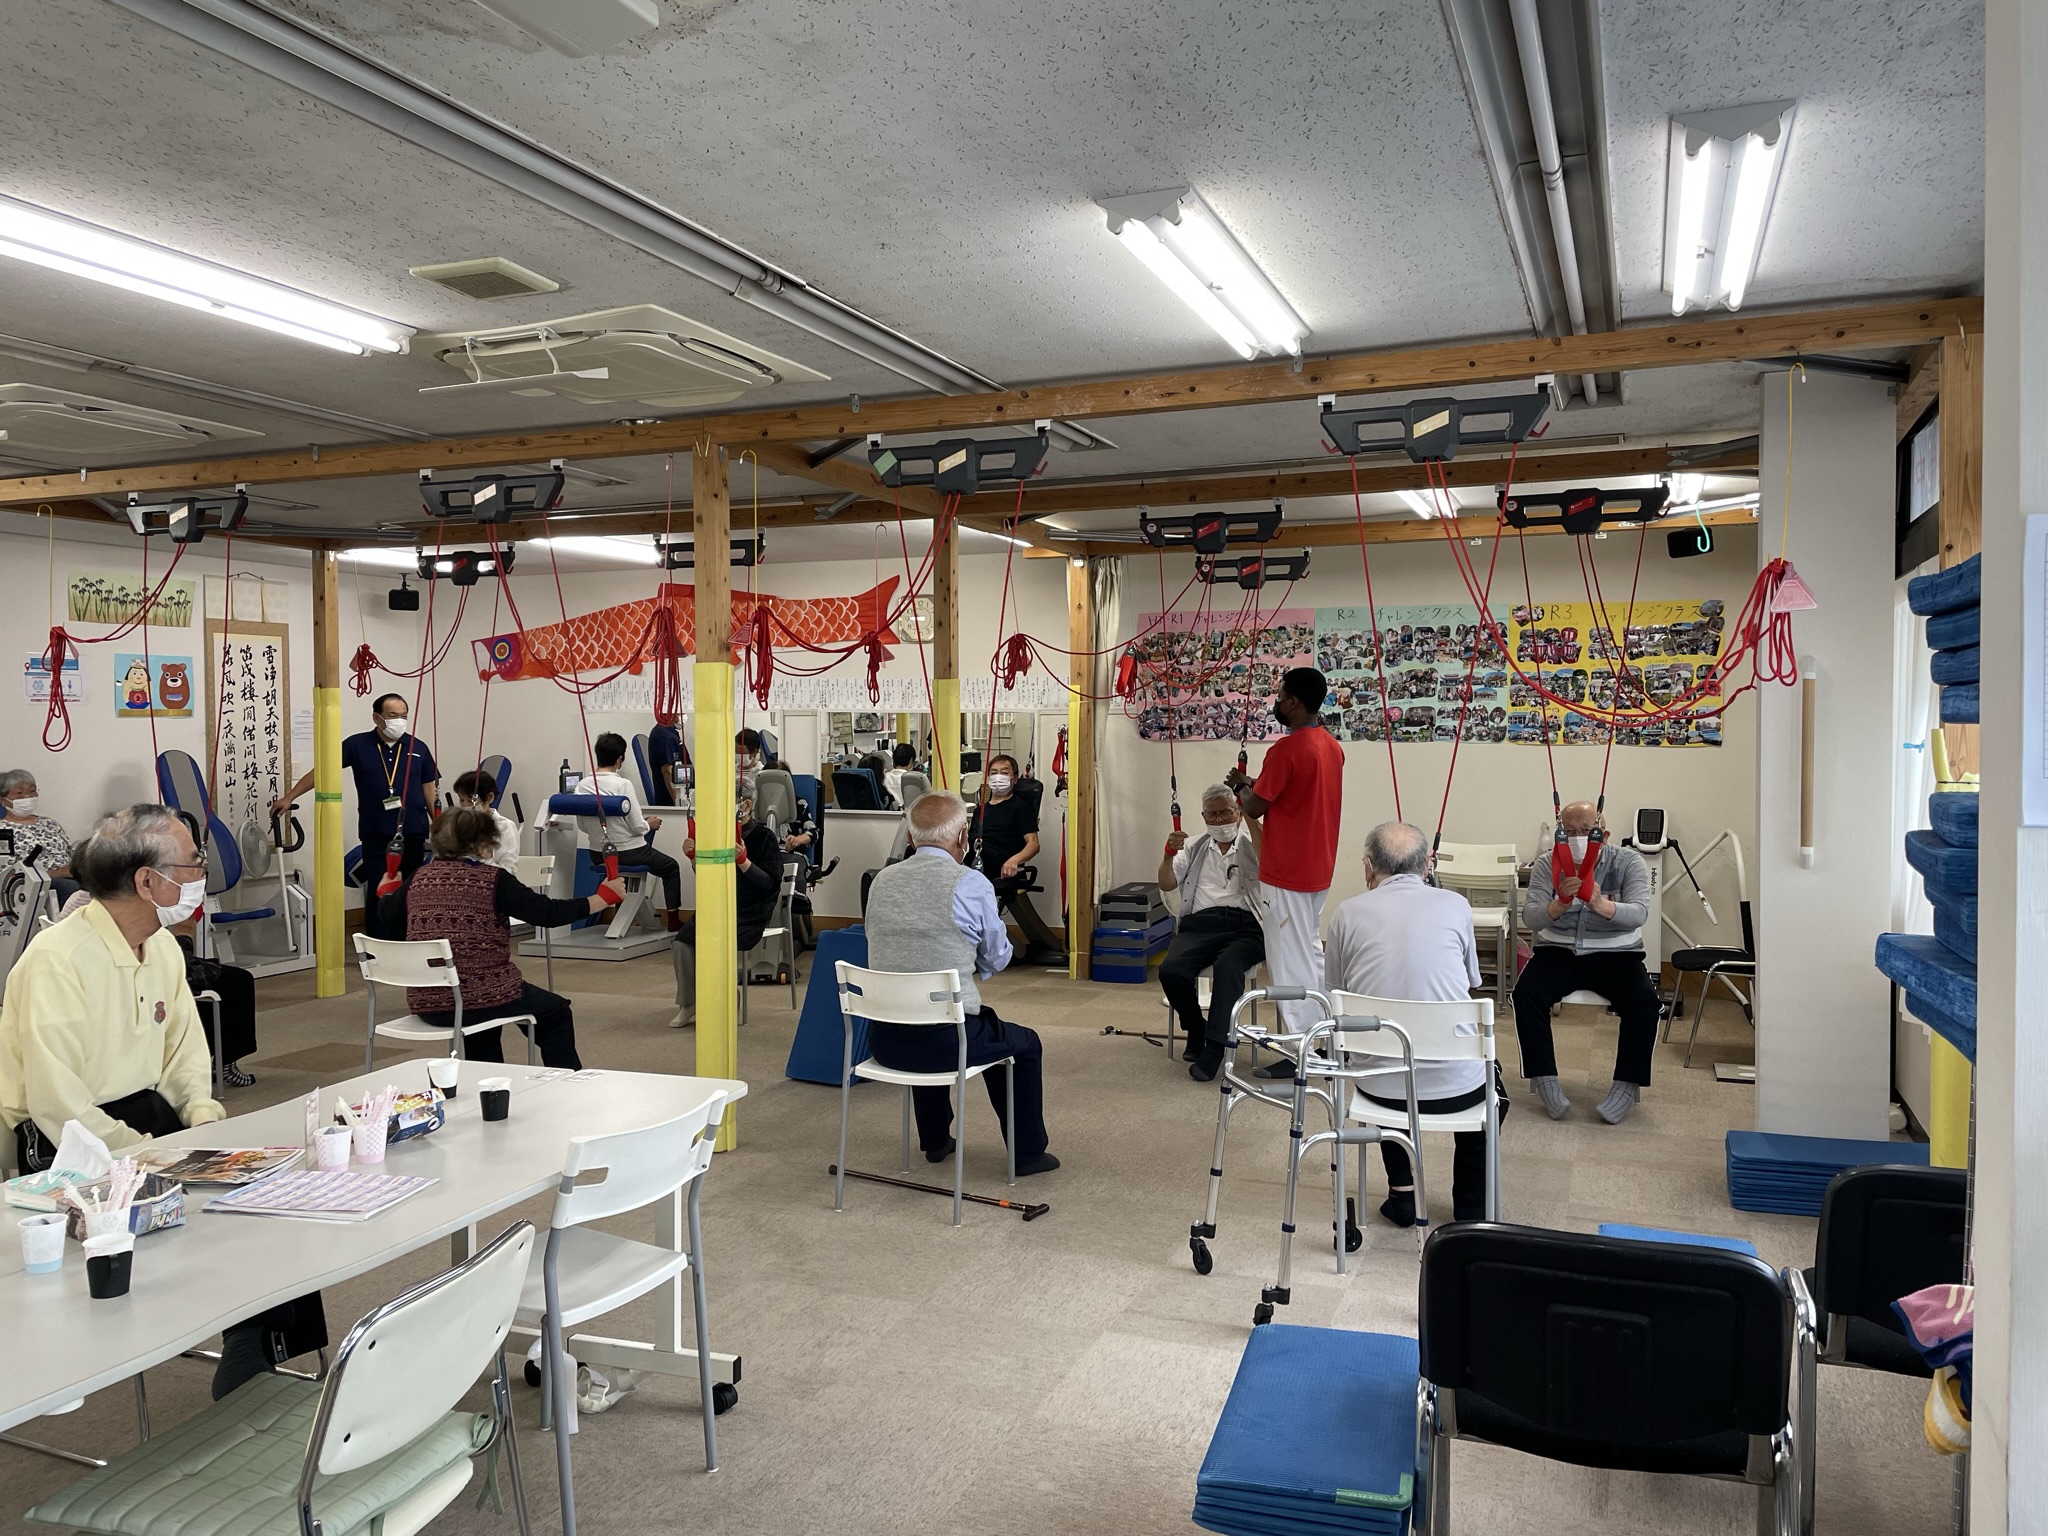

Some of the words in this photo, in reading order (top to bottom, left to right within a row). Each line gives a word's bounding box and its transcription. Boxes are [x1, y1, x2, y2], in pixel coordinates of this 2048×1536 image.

[1337, 608, 1357, 621] R2
[1375, 607, 1466, 623] チャレンジクラス
[1550, 604, 1572, 621] R3
